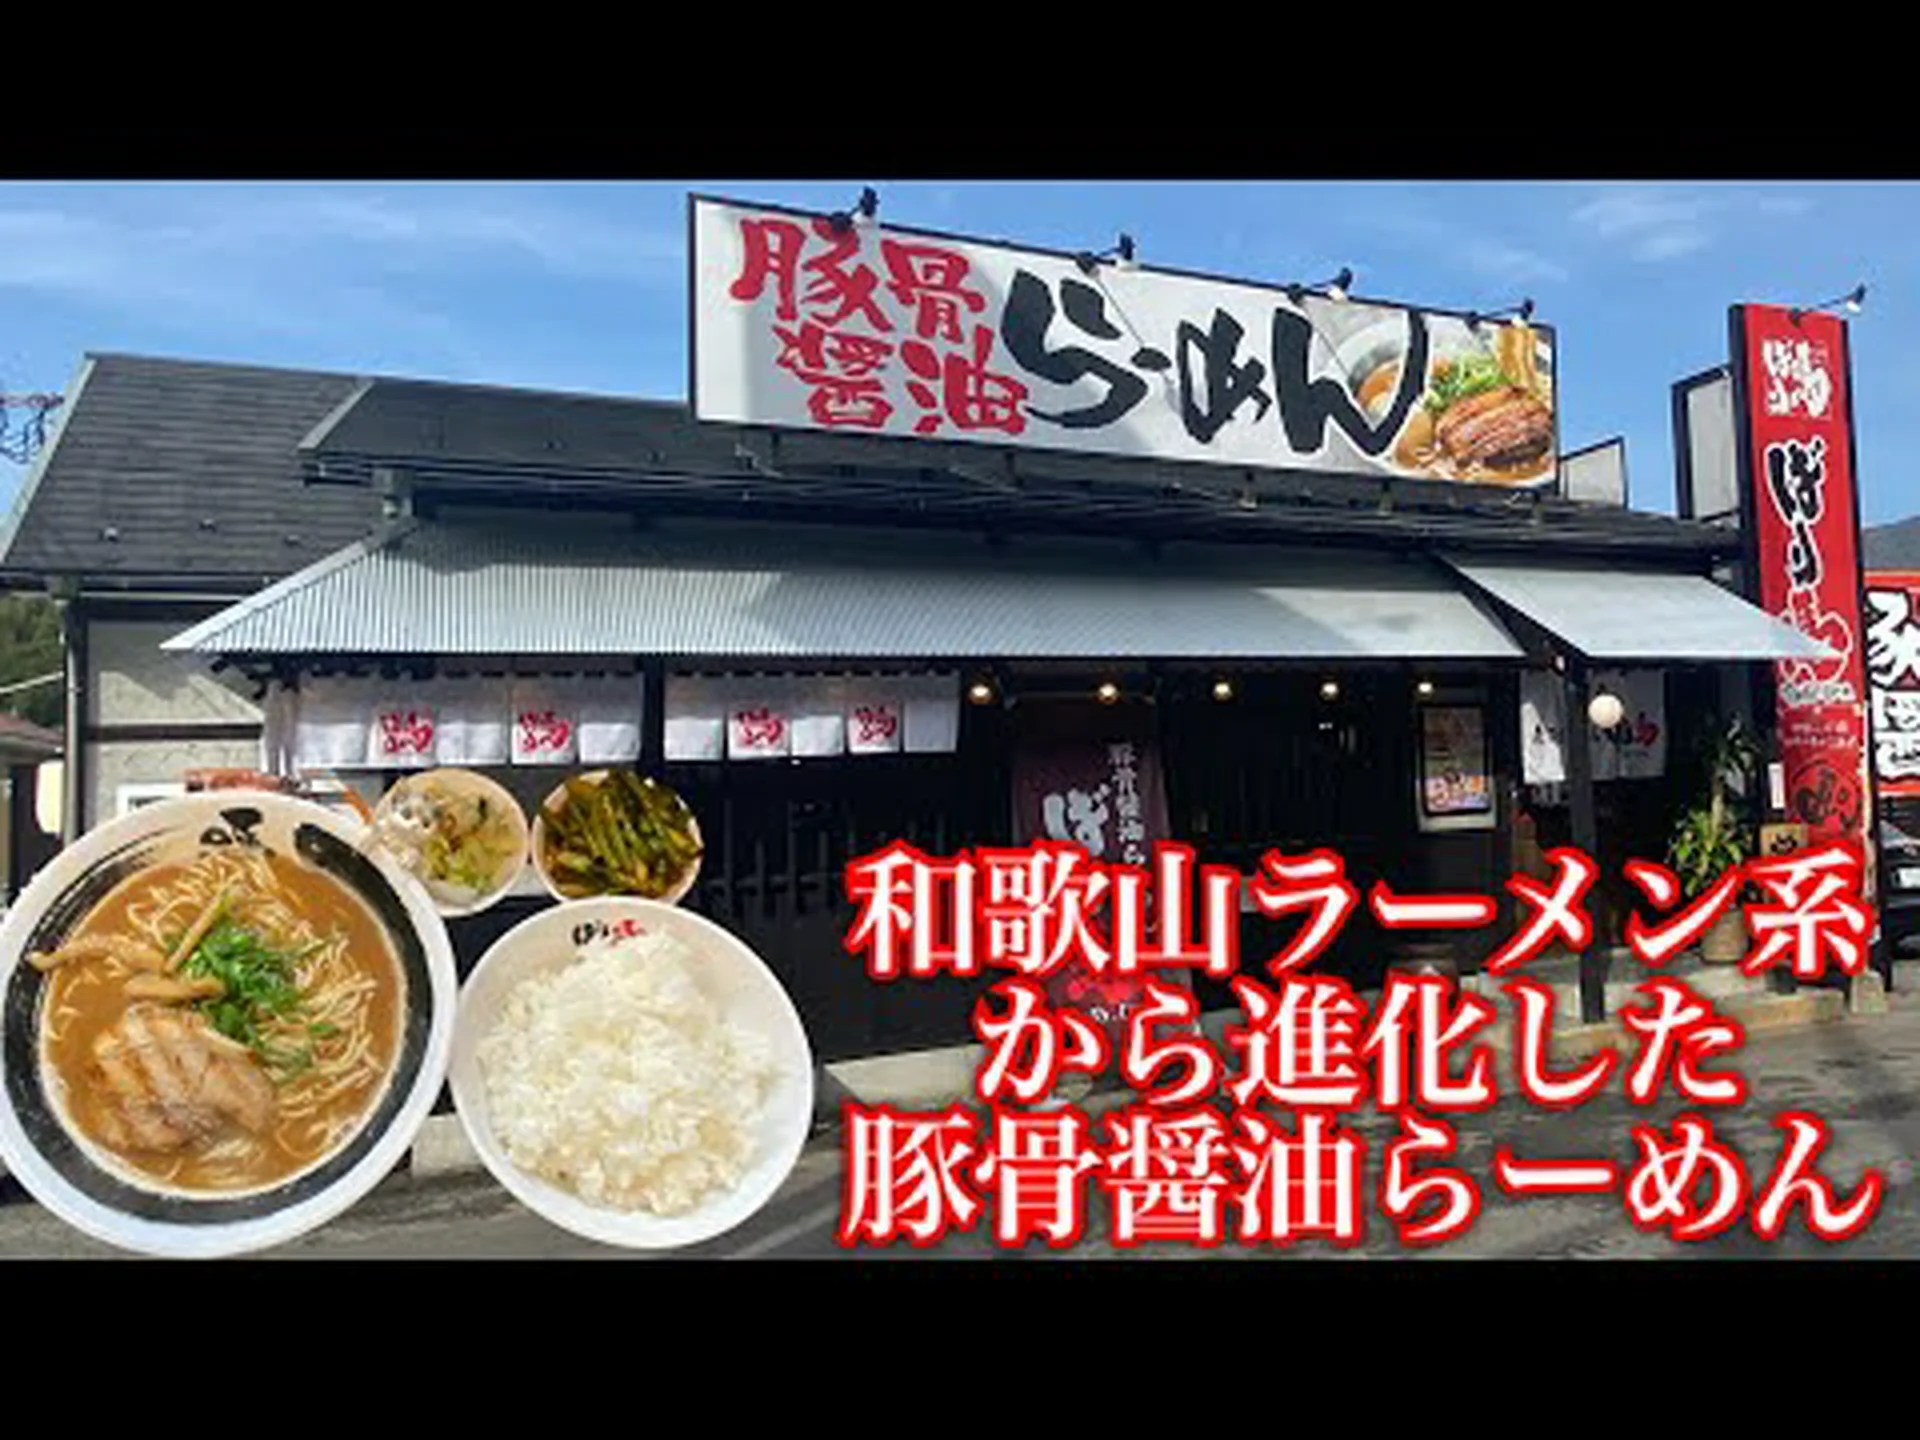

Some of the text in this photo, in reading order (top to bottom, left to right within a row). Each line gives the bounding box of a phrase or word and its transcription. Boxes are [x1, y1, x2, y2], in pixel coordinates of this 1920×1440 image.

[730, 217, 986, 343] 豚骨
[773, 321, 1028, 436] 醤油
[1002, 268, 1429, 456] らーめん
